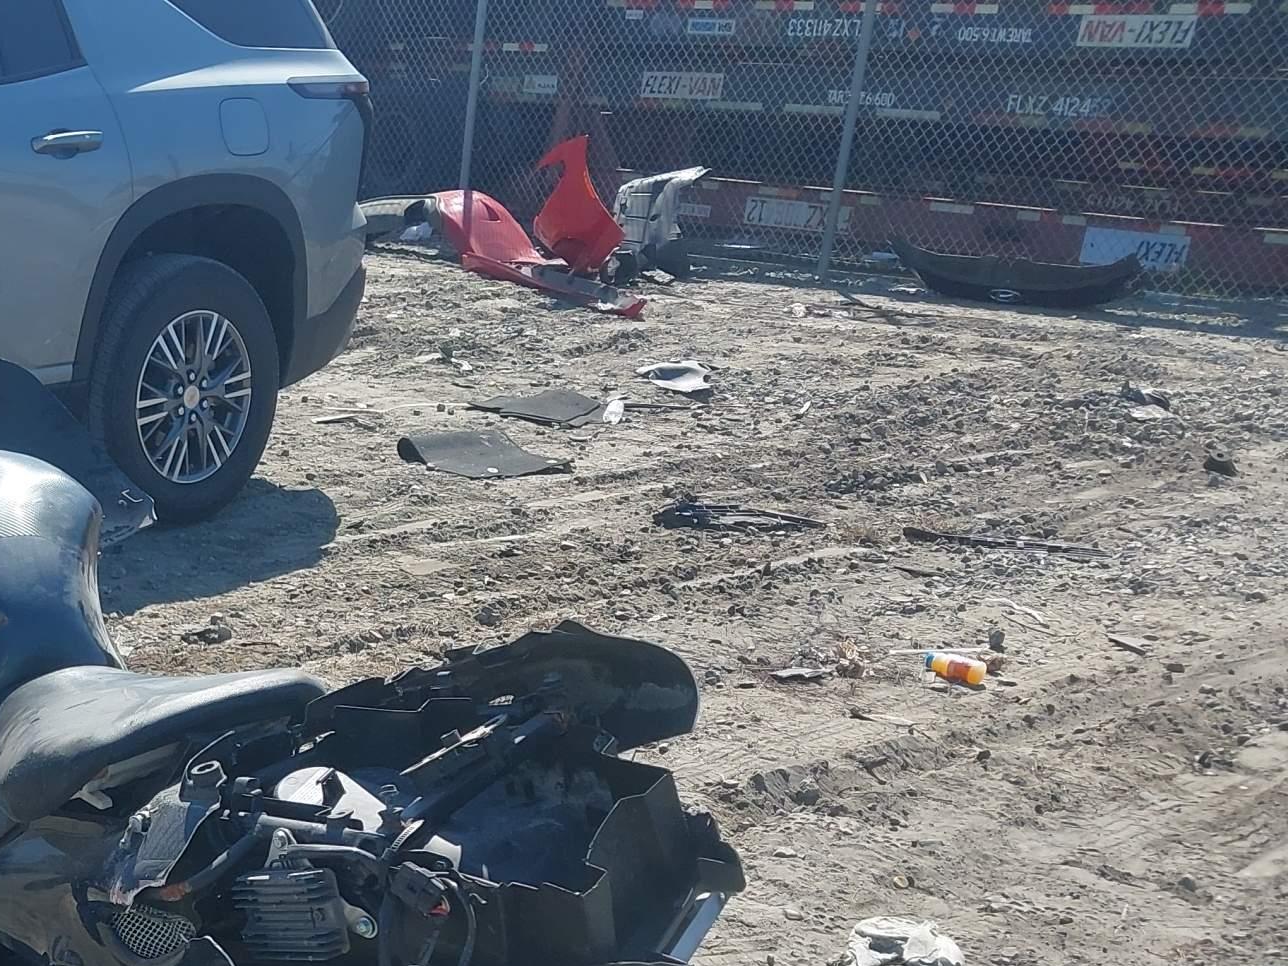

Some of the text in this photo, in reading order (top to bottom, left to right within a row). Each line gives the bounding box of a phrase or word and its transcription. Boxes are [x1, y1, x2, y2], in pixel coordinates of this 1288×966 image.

[1080, 19, 1194, 45] FLEXI-VAN
[643, 73, 722, 98] FLEXI-VAN
[1006, 94, 1049, 115] FLXZ
